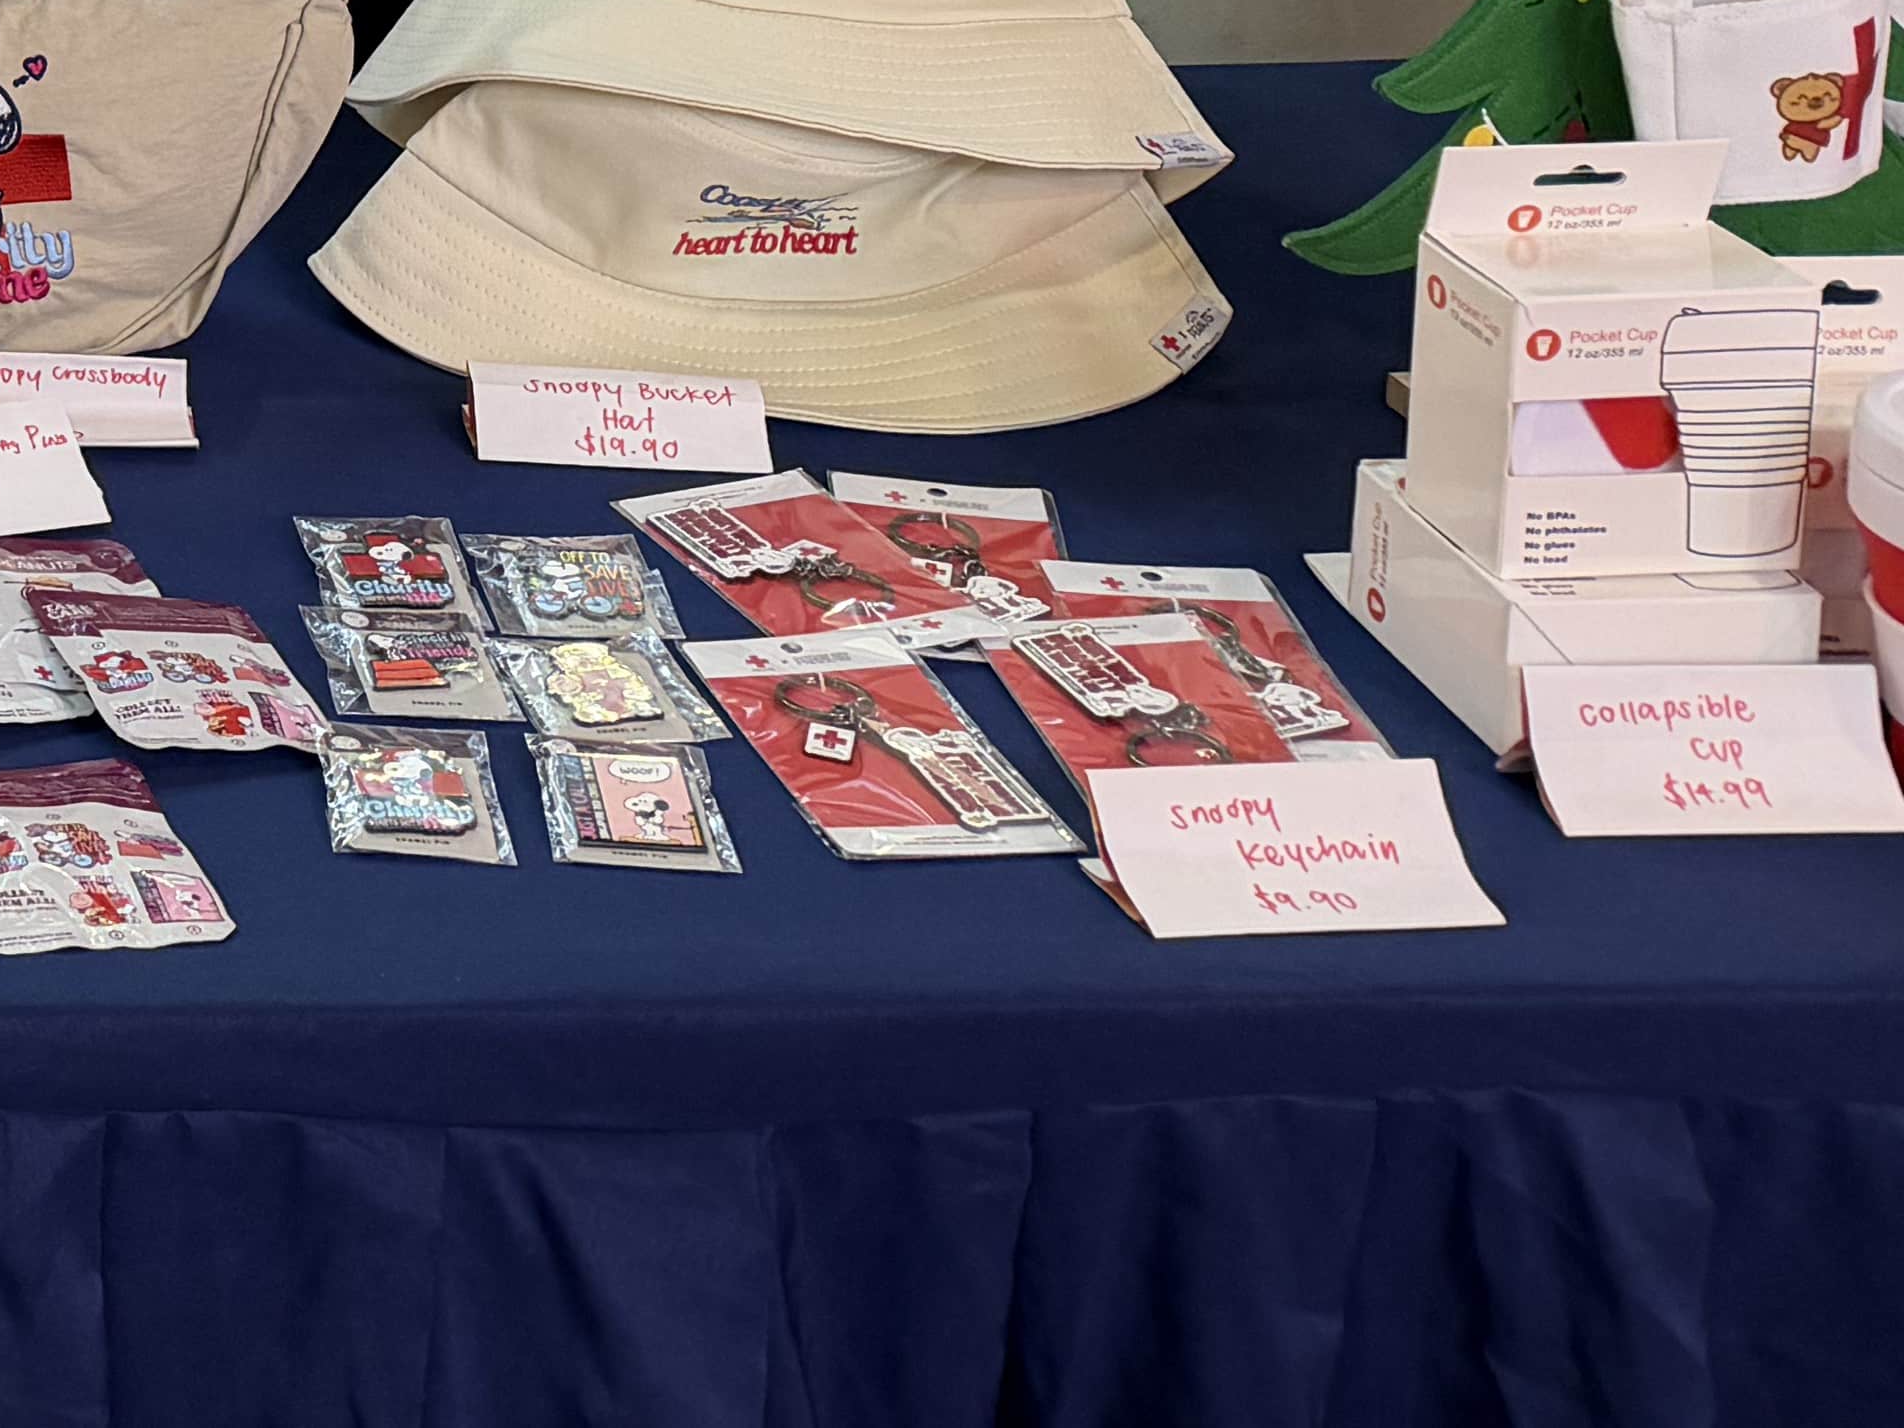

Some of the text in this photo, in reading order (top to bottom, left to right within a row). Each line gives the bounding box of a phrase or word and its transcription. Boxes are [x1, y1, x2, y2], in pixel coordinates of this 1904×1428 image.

[1551, 203, 1638, 218] Pocket Cup
[673, 225, 860, 257] heart to heart
[1570, 328, 1658, 345] Pocket Cup
[1868, 326, 1899, 342] Cup
[1567, 347, 1644, 359] 12 oz/355 ml
[601, 406, 656, 432] Hat
[575, 430, 680, 460] $19.90
[1526, 511, 1577, 521] No BPAs
[1525, 525, 1608, 537] No phthalates
[1524, 540, 1576, 551] No glues
[559, 551, 610, 564] OFF TO
[1523, 555, 1540, 564] No
[583, 564, 630, 580] SAVE
[353, 578, 452, 597] Charity
[619, 765, 660, 777] WOOF!
[1664, 776, 1773, 811] $14.99
[1253, 883, 1359, 915] $9.90
